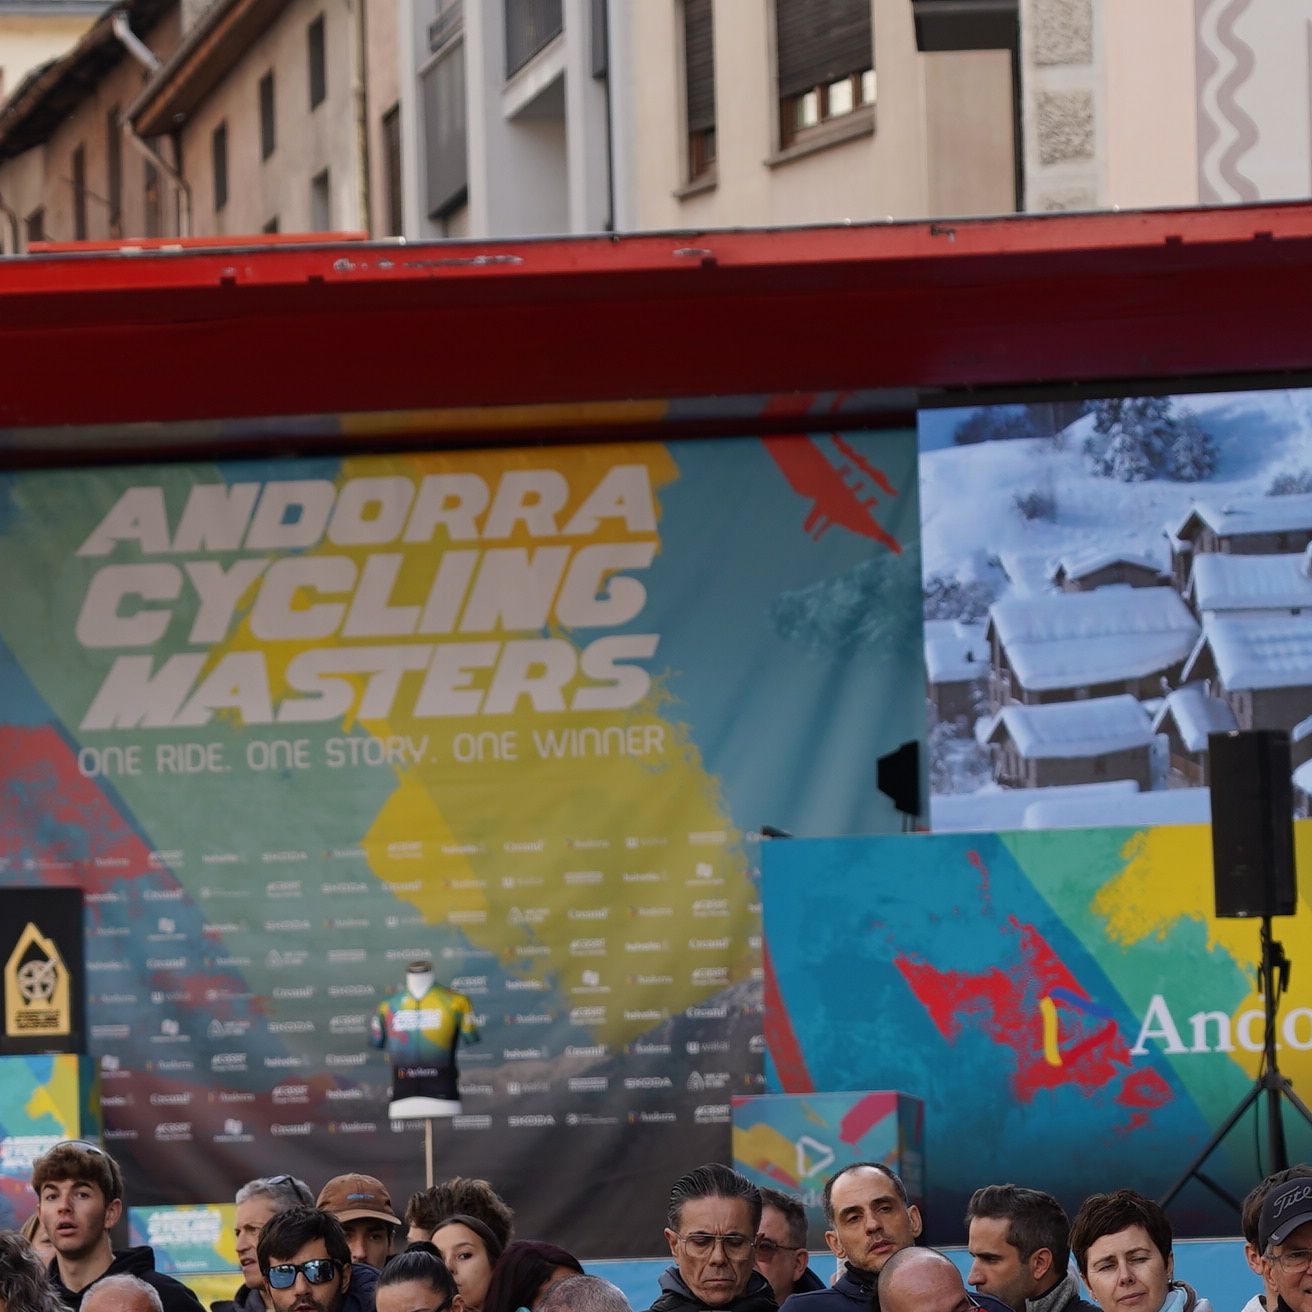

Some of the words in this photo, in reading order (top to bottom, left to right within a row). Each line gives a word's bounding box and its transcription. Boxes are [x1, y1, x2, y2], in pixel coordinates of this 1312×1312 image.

[75, 464, 658, 556] ANDORRA
[75, 541, 658, 648] CYCLING
[79, 633, 661, 731] MASTERS
[77, 745, 142, 778] ONE
[156, 741, 232, 774] RIDE.
[246, 738, 311, 771] ONE
[324, 735, 439, 768] STORY.
[452, 731, 519, 764] ONE
[531, 725, 666, 761] WINNER
